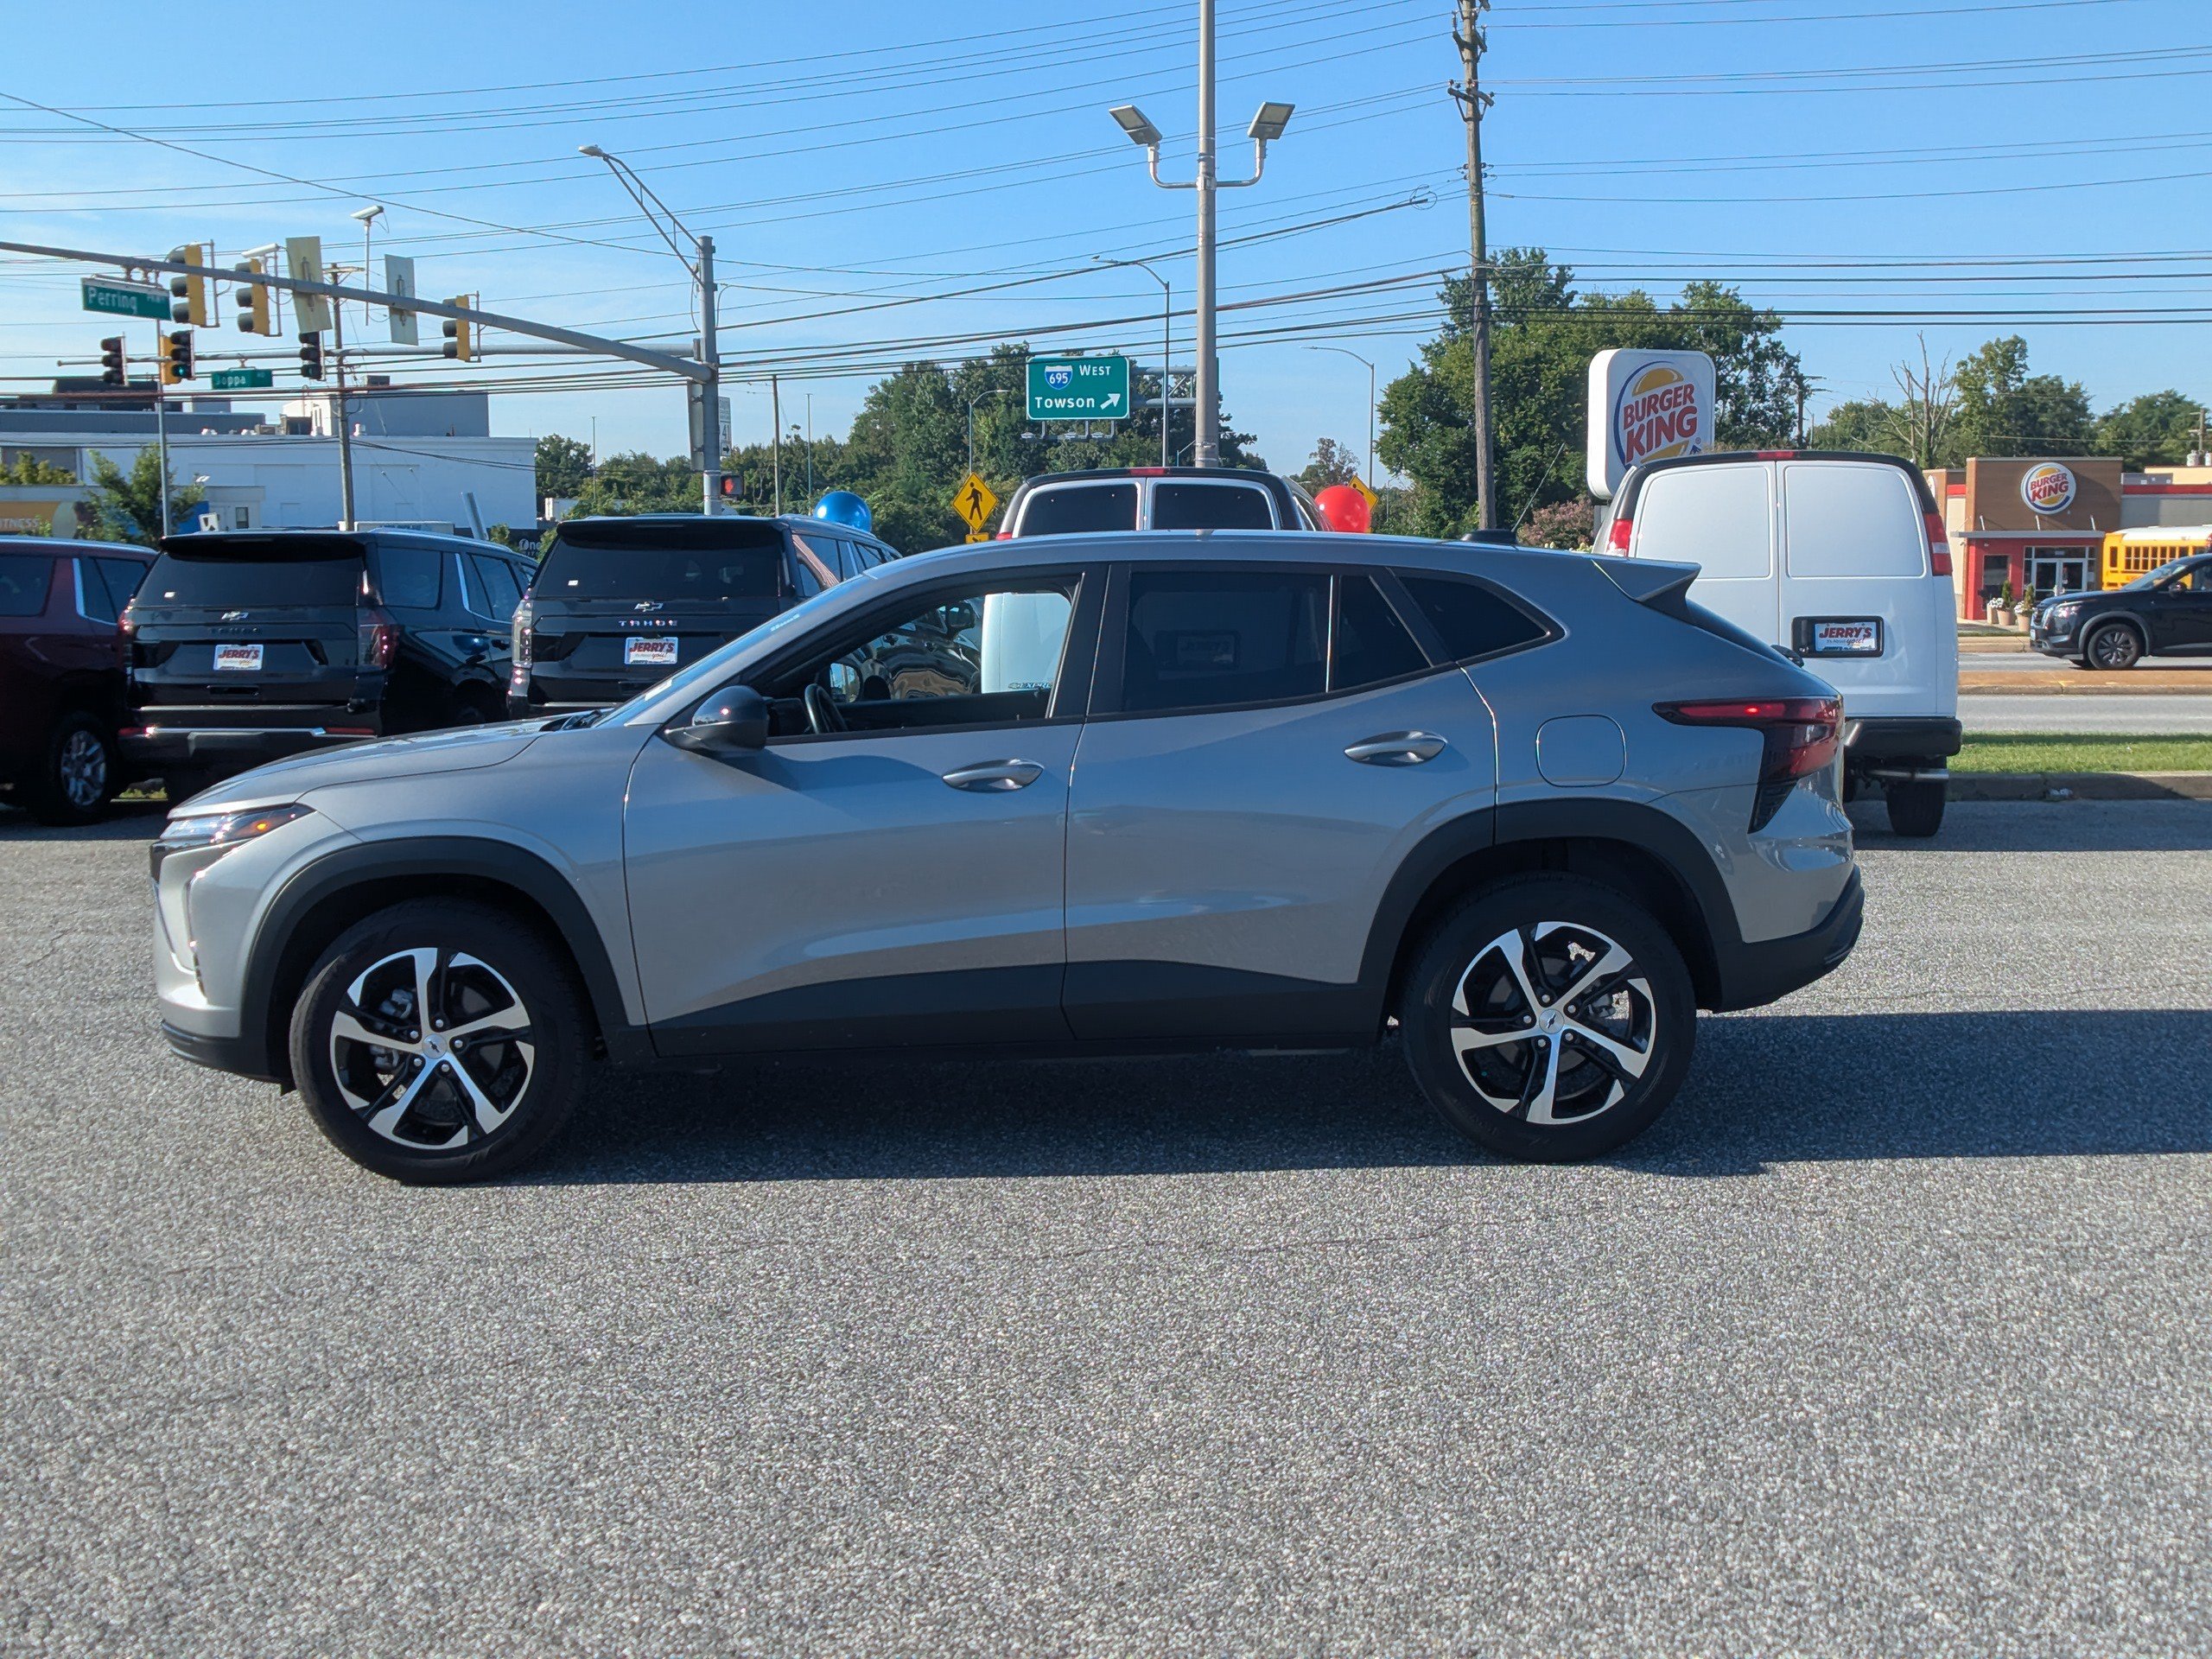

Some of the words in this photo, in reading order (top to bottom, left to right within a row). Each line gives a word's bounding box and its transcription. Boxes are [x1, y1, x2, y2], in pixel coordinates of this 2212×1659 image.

[87, 286, 137, 315] Perring
[214, 373, 246, 387] Joppa
[1049, 372, 1069, 384] 695
[1079, 365, 1111, 376] WEST
[1034, 397, 1095, 409] Towson
[1624, 383, 1694, 430] BURGER
[1626, 405, 1698, 463] KING
[2031, 473, 2068, 491] BURGER
[2031, 480, 2069, 502] KING
[1819, 627, 1872, 639] JERRY'S
[218, 650, 259, 659] JERRY'S
[629, 642, 675, 653] JERRY'S
